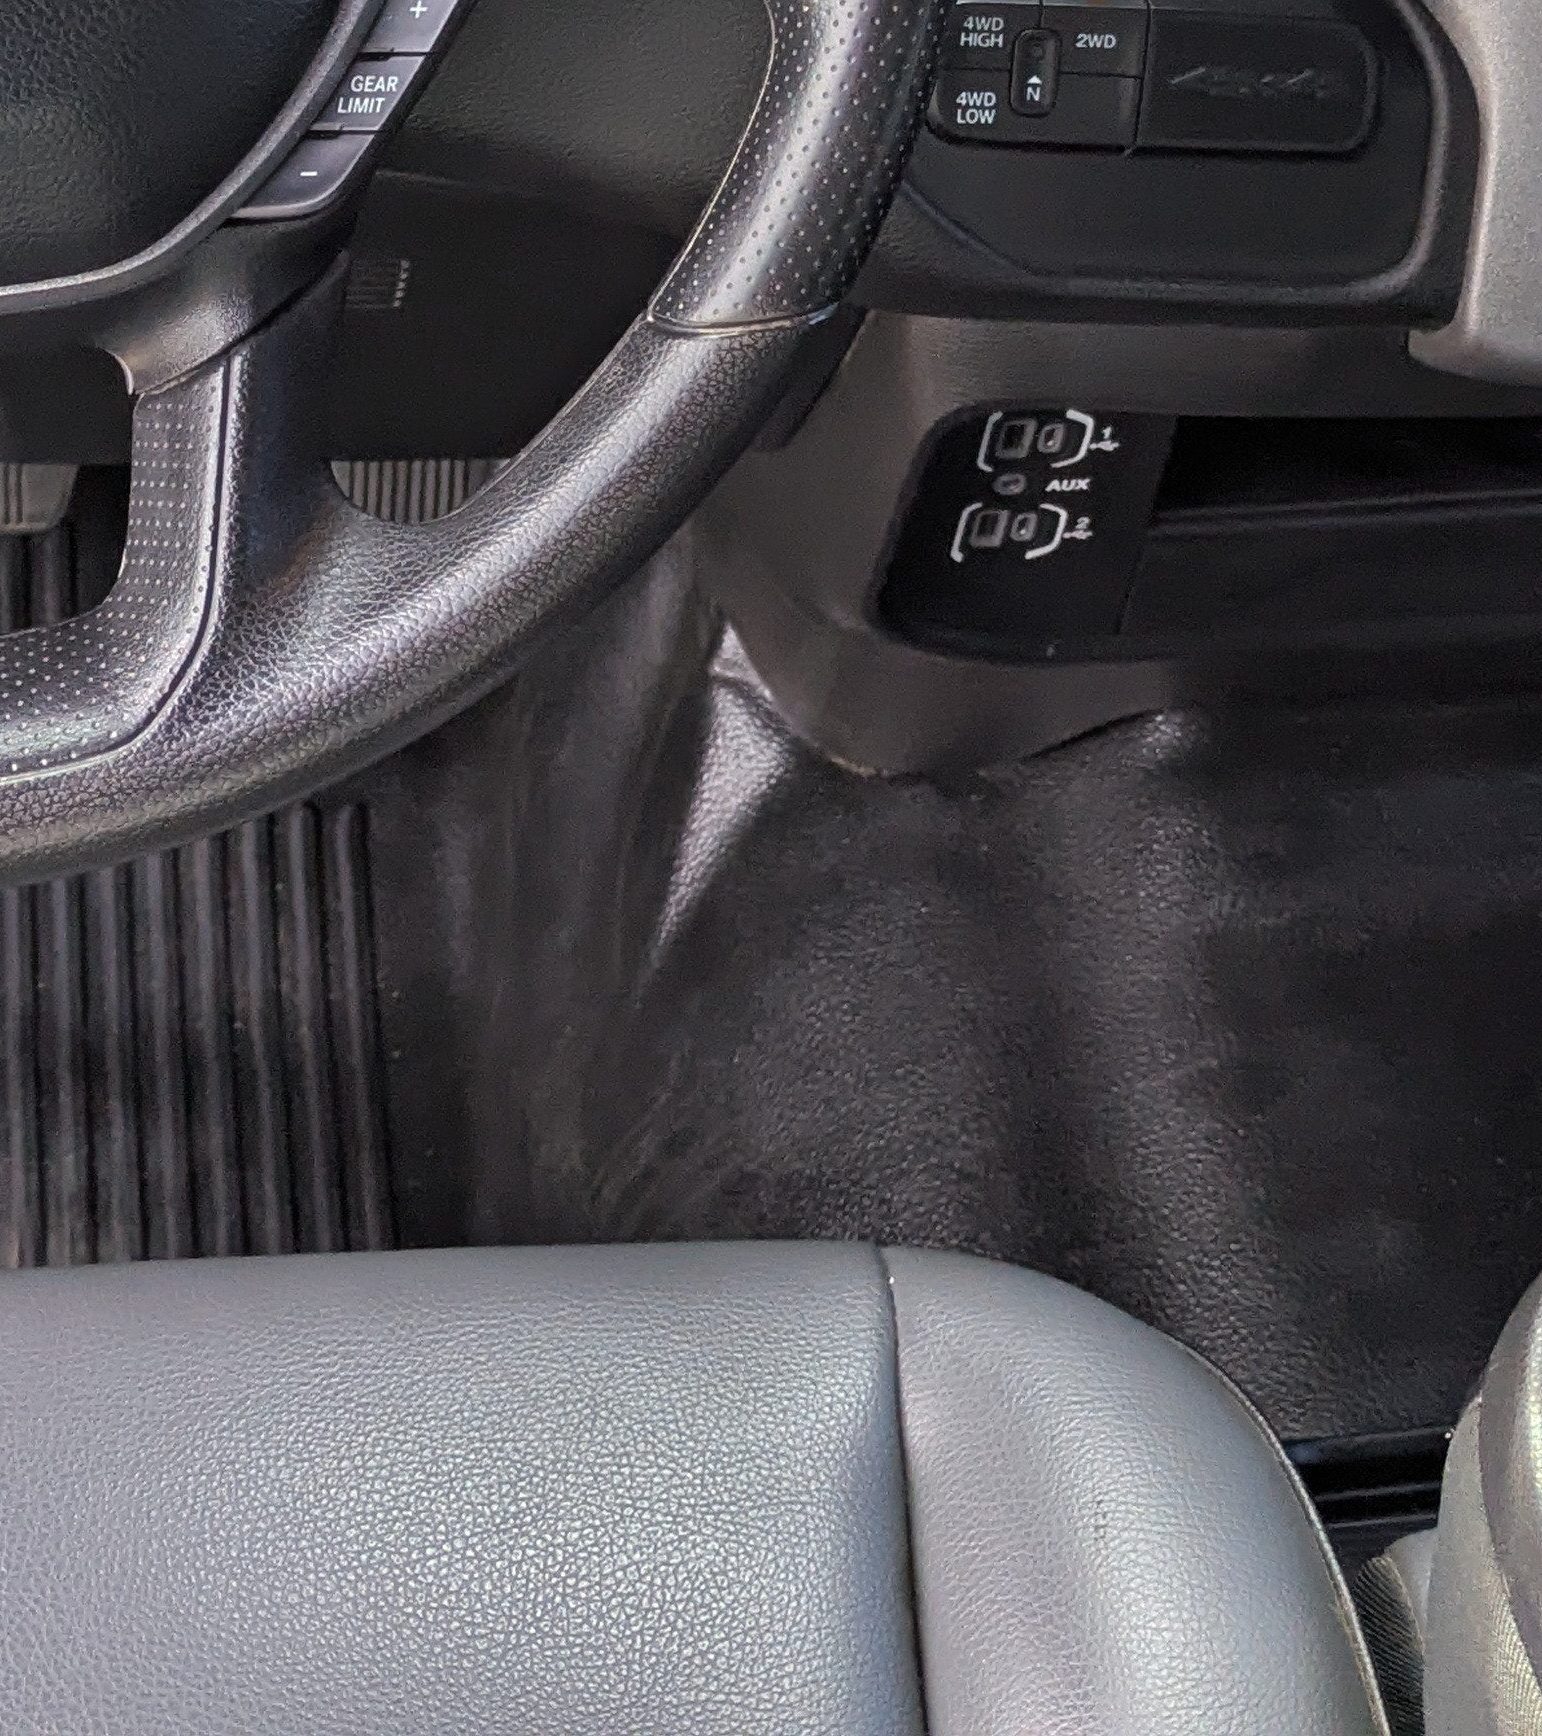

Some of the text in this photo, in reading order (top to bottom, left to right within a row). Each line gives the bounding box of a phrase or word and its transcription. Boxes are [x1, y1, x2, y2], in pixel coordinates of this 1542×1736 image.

[962, 16, 1005, 32] 4WD
[960, 31, 1004, 49] HIGH
[1075, 33, 1116, 49] 2WD
[350, 75, 399, 93] GEAR
[955, 91, 997, 107] 4WD
[1026, 87, 1040, 102] N
[337, 97, 386, 114] LIMIT
[956, 108, 997, 125] LOW
[1045, 478, 1092, 492] AUX
